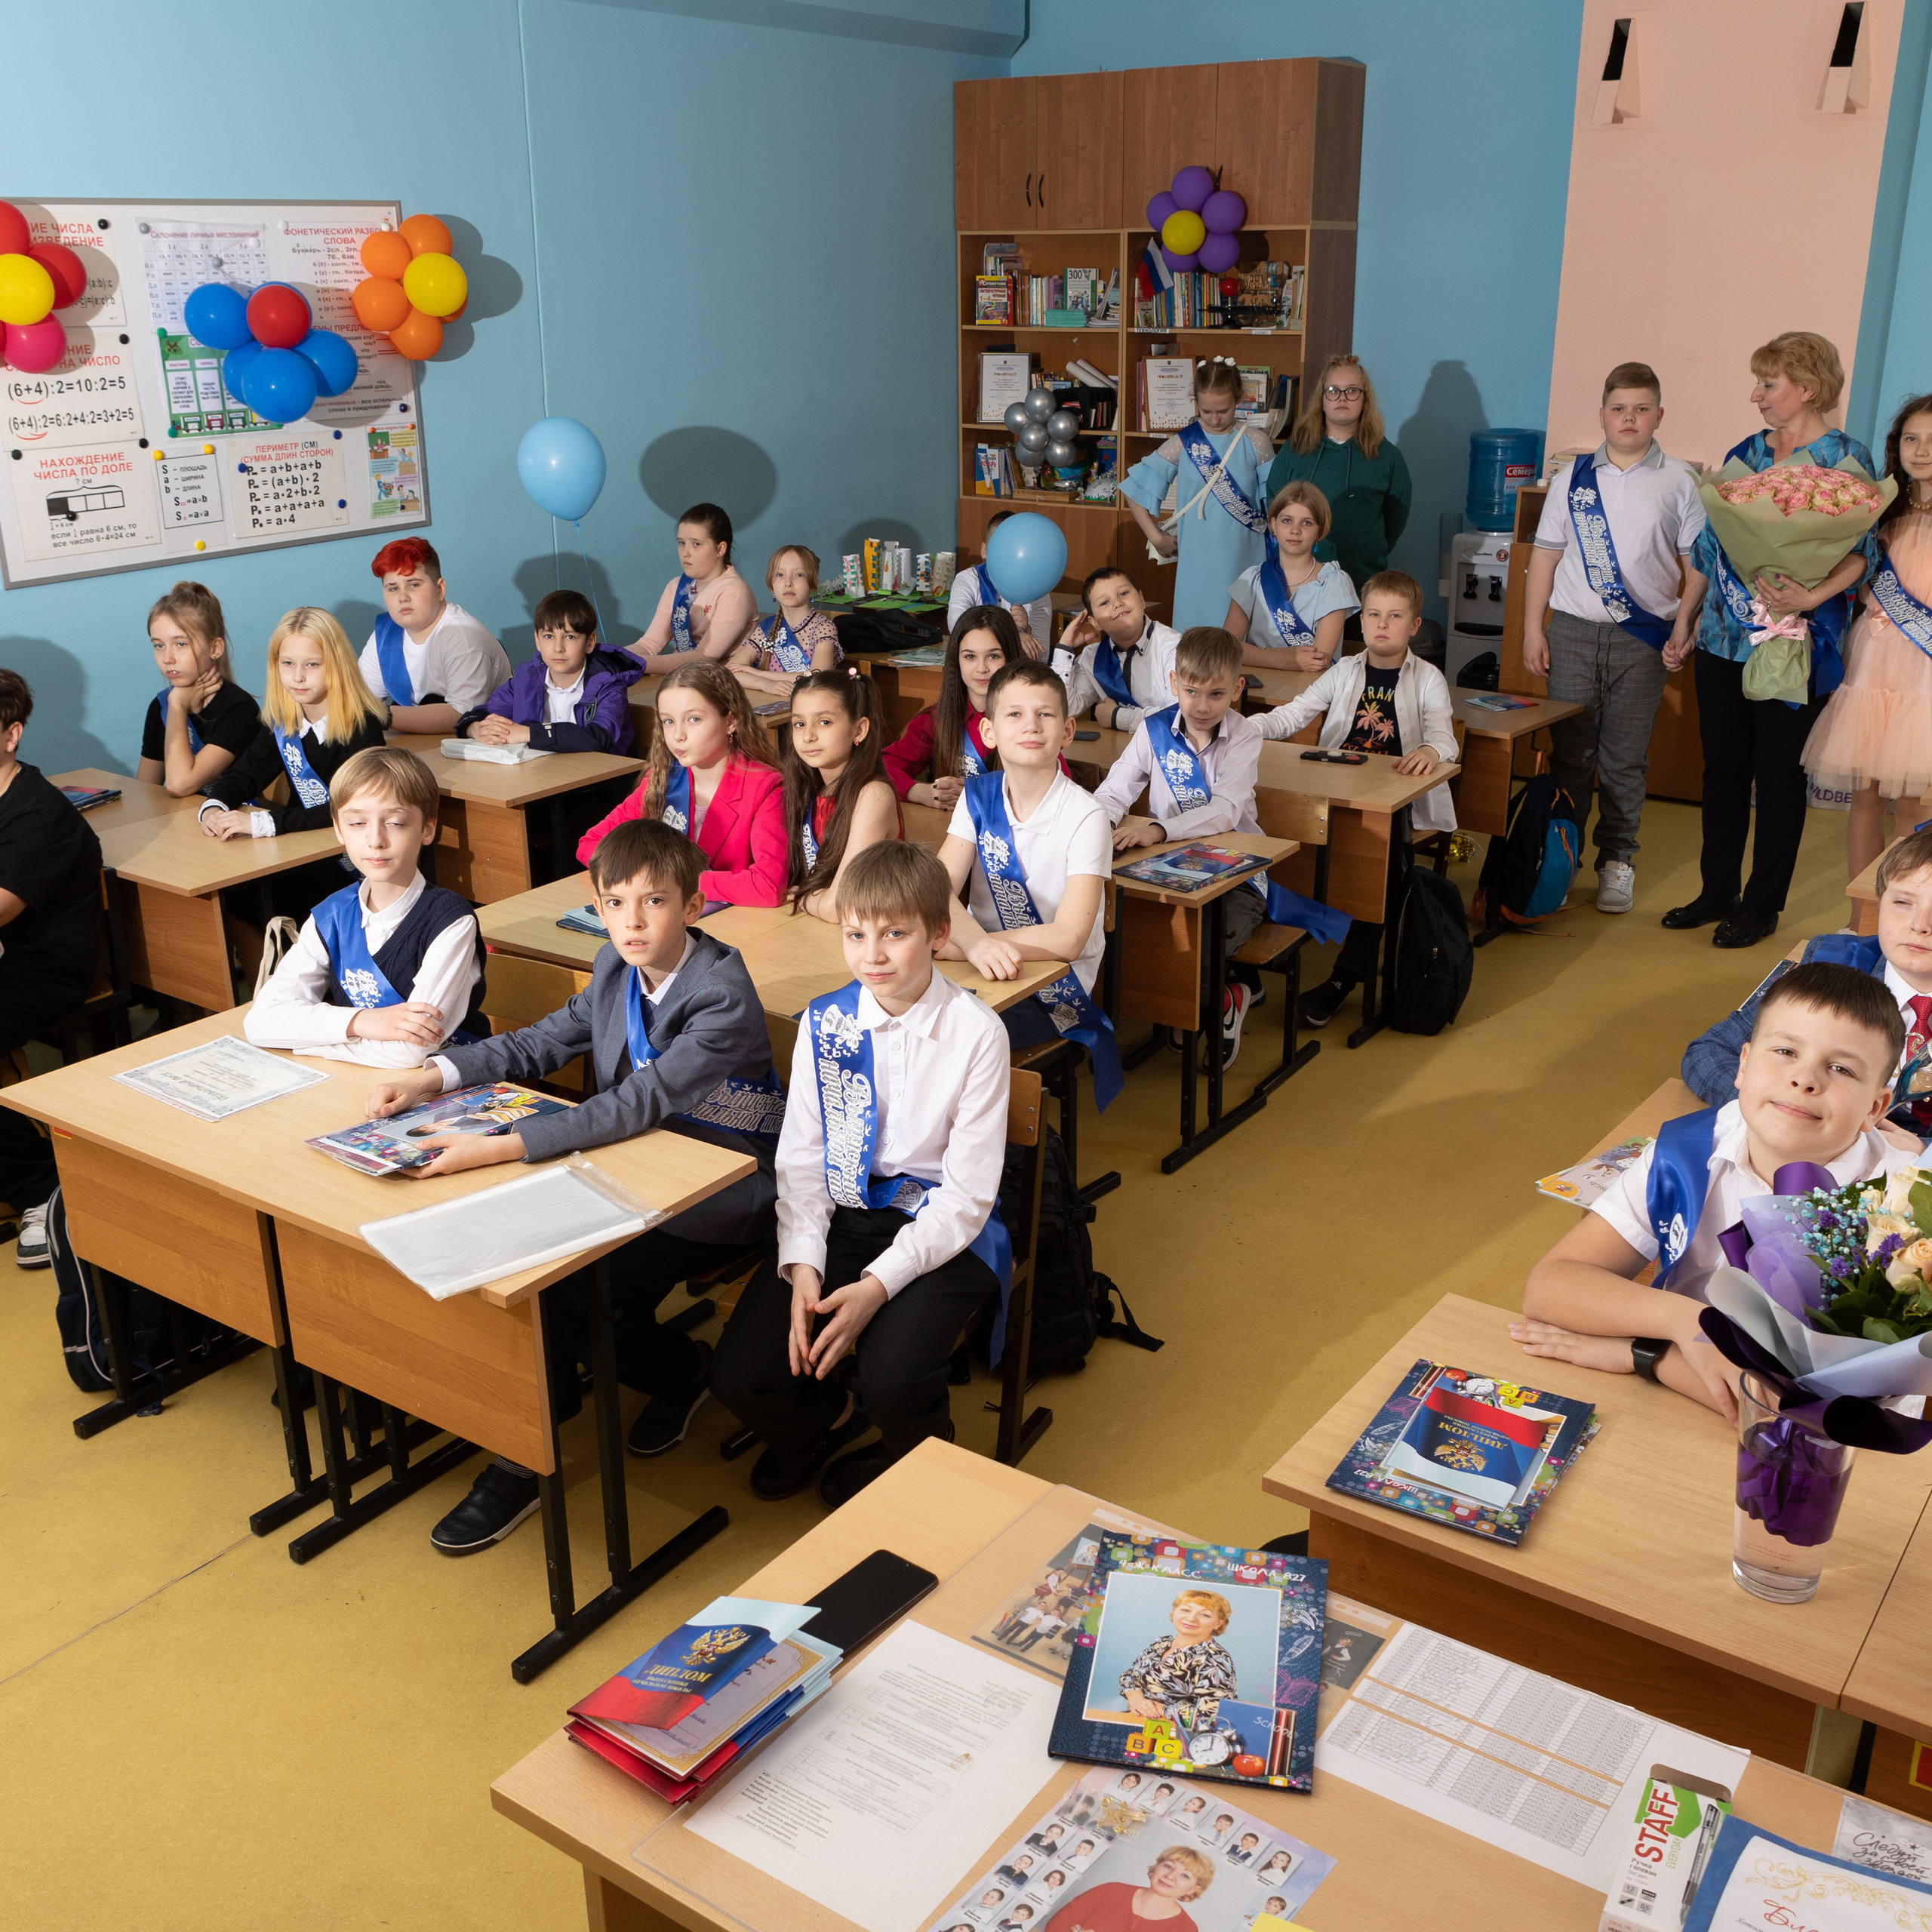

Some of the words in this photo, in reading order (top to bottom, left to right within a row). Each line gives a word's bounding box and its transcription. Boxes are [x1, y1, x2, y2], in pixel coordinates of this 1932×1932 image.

[51, 223, 94, 233] ЧИСЛА
[284, 227, 353, 235] ФОНЕТИЧЕСКИЙ
[1069, 270, 1082, 279] 300
[60, 360, 75, 368] НА
[79, 355, 121, 367] ЧИСЛО
[256, 442, 299, 453] ПЕРИМЕТР
[302, 441, 318, 450] (СМ)
[39, 452, 125, 469] НАХОЖДЕНИЕ
[241, 454, 272, 463] (СУММА
[275, 452, 297, 461] ДЛИН
[300, 448, 334, 459] СТОРОН)
[34, 469, 77, 481] ЧИСЛА
[81, 466, 97, 476] ПО
[102, 462, 134, 475] ДОЛЕ
[162, 465, 168, 474] S
[51, 531, 71, 540] если
[80, 528, 104, 537] равна
[69, 537, 94, 546] число
[1878, 571, 1932, 635] Выпускни
[685, 1102, 764, 1131] чальной
[1437, 1420, 1508, 1451] ДИПЛОМ
[1354, 1469, 1374, 1480] 827
[1283, 1572, 1306, 1583] 827
[642, 1664, 713, 1682] ДИПЛОМ
[632, 1680, 667, 1690] НАЧАЛЬНОЙ
[669, 1684, 692, 1693] ШКОЛЫ
[647, 1676, 689, 1687] ВЫПУСКНИКА
[1152, 1724, 1164, 1737] A
[1253, 1715, 1295, 1739] SCHOOL
[1133, 1739, 1144, 1750] B
[1162, 1744, 1175, 1755] C
[1635, 1788, 1679, 1863] STAFF
[1666, 1837, 1683, 1869] EVERYDAY
[1853, 1832, 1924, 1863] Следуй
[1632, 1857, 1653, 1869] Ручка
[1853, 1847, 1878, 1859] за
[1881, 1854, 1930, 1875] своей
[1629, 1865, 1657, 1877] гелевая
